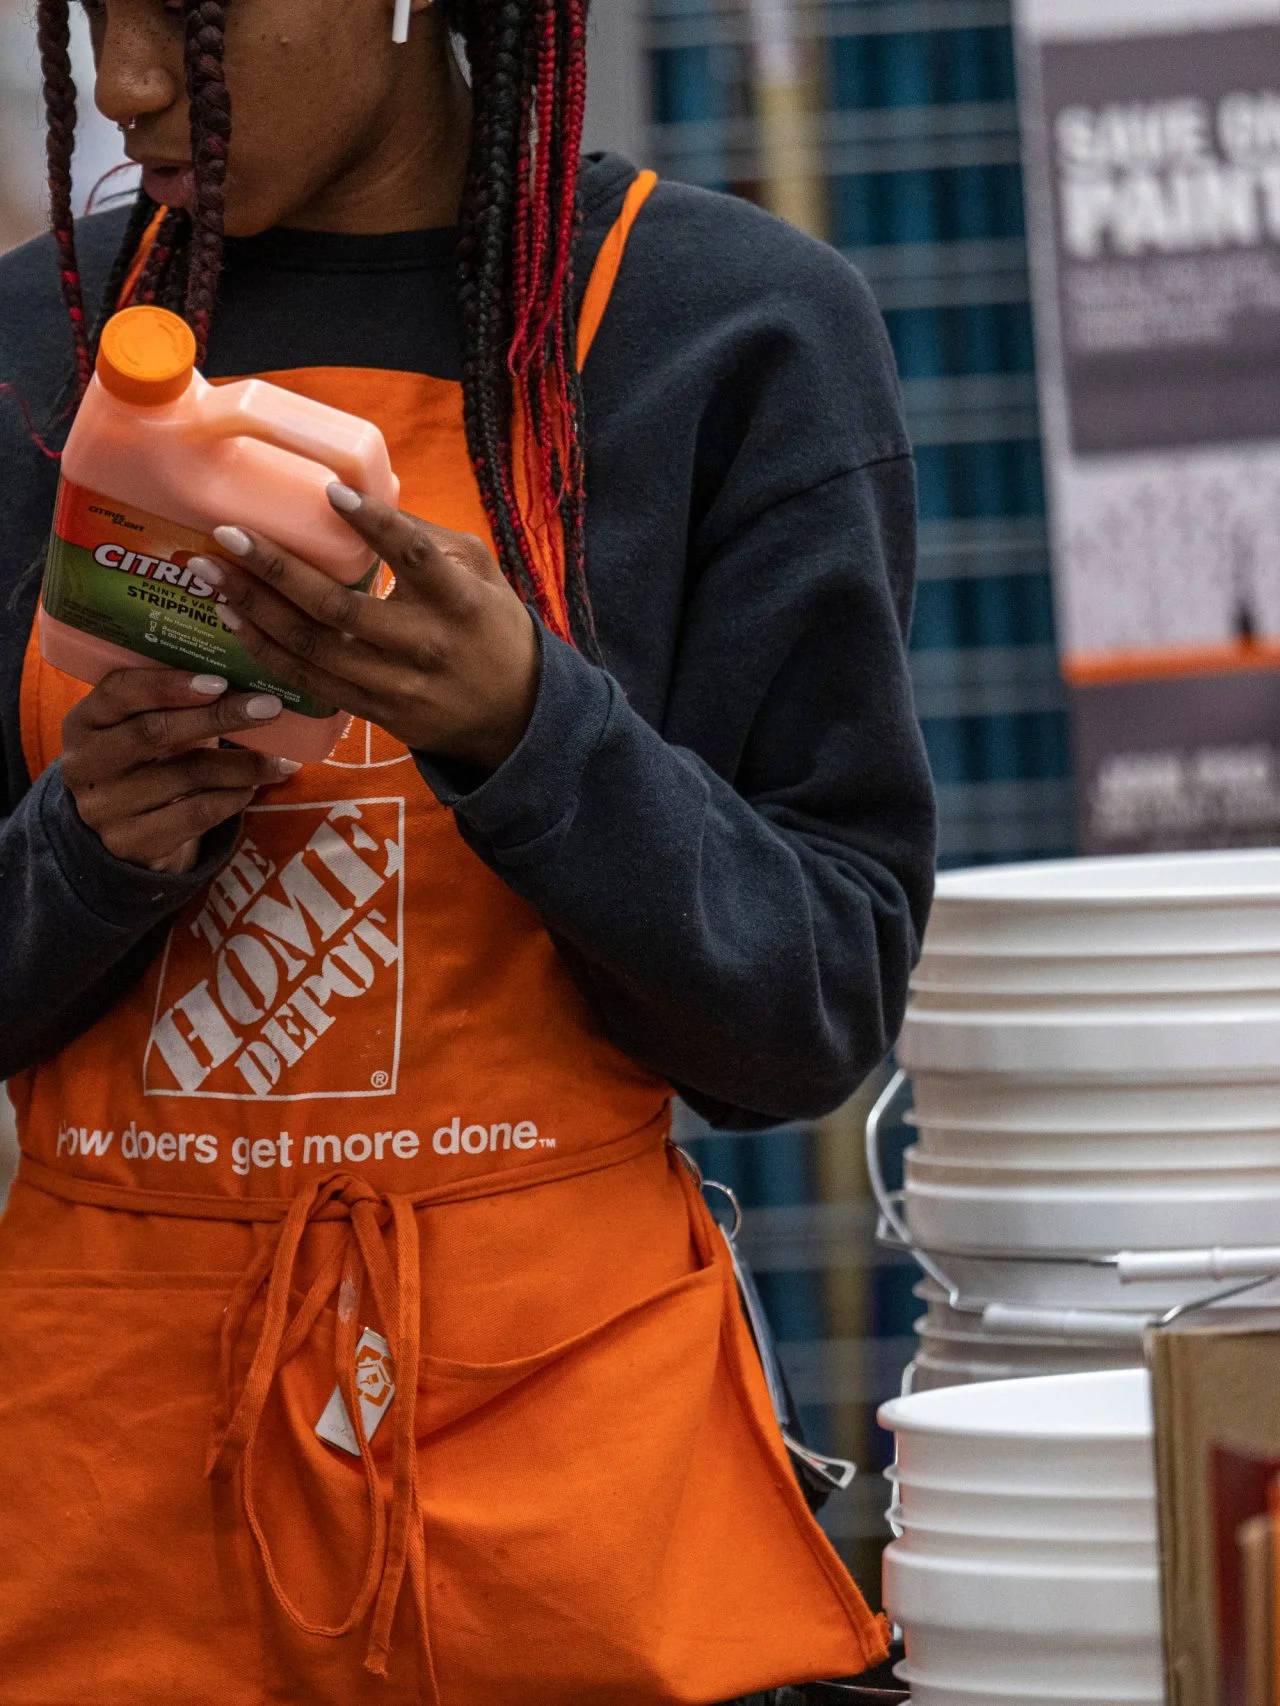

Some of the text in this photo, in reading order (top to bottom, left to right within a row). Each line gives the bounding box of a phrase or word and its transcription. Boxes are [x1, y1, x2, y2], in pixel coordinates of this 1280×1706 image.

[92, 541, 228, 604] CITRIS
[142, 581, 176, 599] PAINT
[192, 599, 218, 616] VAR
[127, 585, 218, 629] STRIPPING
[189, 838, 277, 953] THE
[152, 802, 402, 1092] HOME
[234, 909, 402, 1097] DEPOT
[121, 1120, 218, 1164] doers
[231, 1131, 294, 1176] get
[302, 1129, 420, 1164] more
[432, 1116, 539, 1156] done
